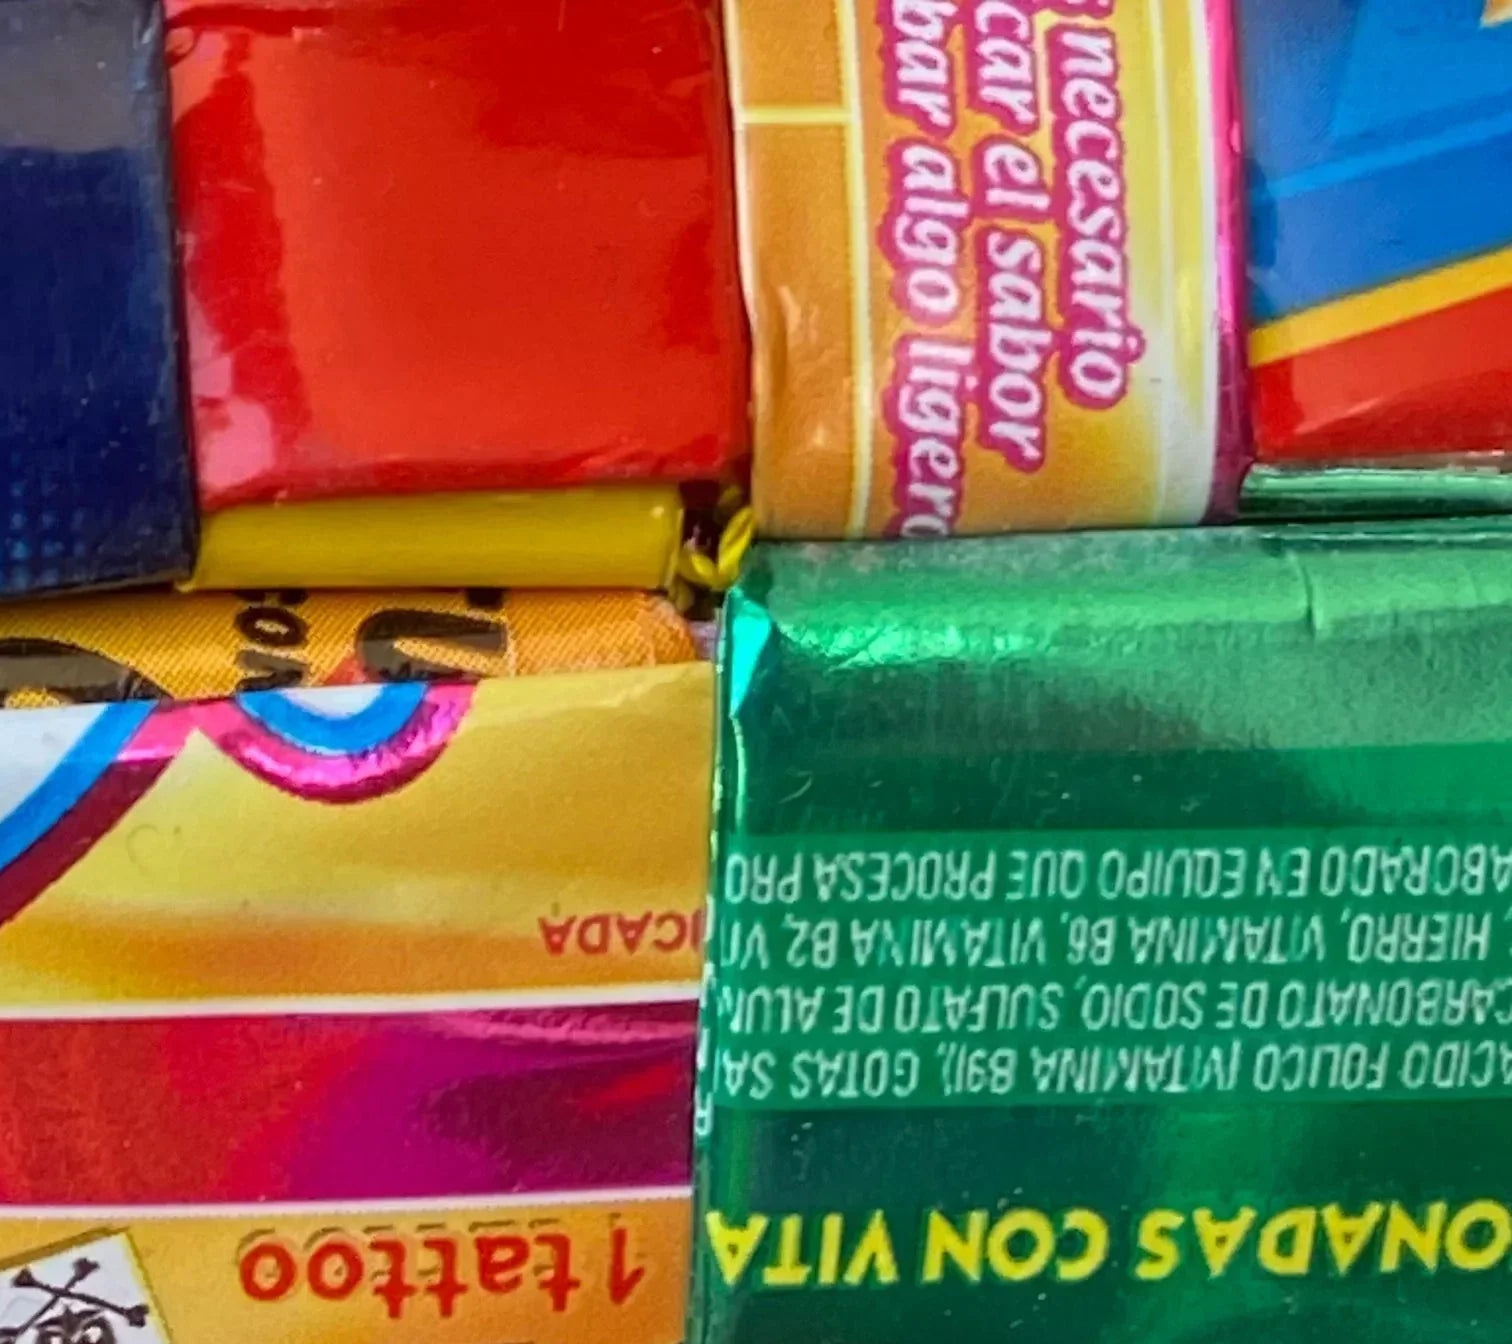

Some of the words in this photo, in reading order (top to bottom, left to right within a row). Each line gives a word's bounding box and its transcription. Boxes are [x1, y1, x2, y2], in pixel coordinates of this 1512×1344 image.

[984, 142, 1052, 210] el
[892, 145, 971, 316] algo
[1061, 29, 1141, 400] necesario
[987, 229, 1052, 461] sabor
[813, 851, 997, 903] PROCESA
[1005, 849, 1087, 901] QUE
[1096, 848, 1247, 900] EQUIPO
[1255, 847, 1310, 898] EN
[848, 916, 1047, 969] VITAMINA
[1126, 915, 1329, 966] VITAMINA
[831, 984, 886, 1034] DE
[893, 981, 1065, 1034] SULFATO
[1214, 981, 1270, 1030] DE
[714, 1048, 777, 1100] SA
[786, 1050, 921, 1099] GOTAS
[705, 1208, 901, 1287] VITA
[922, 1207, 1111, 1283] CON
[239, 1228, 582, 1319] tattoo
